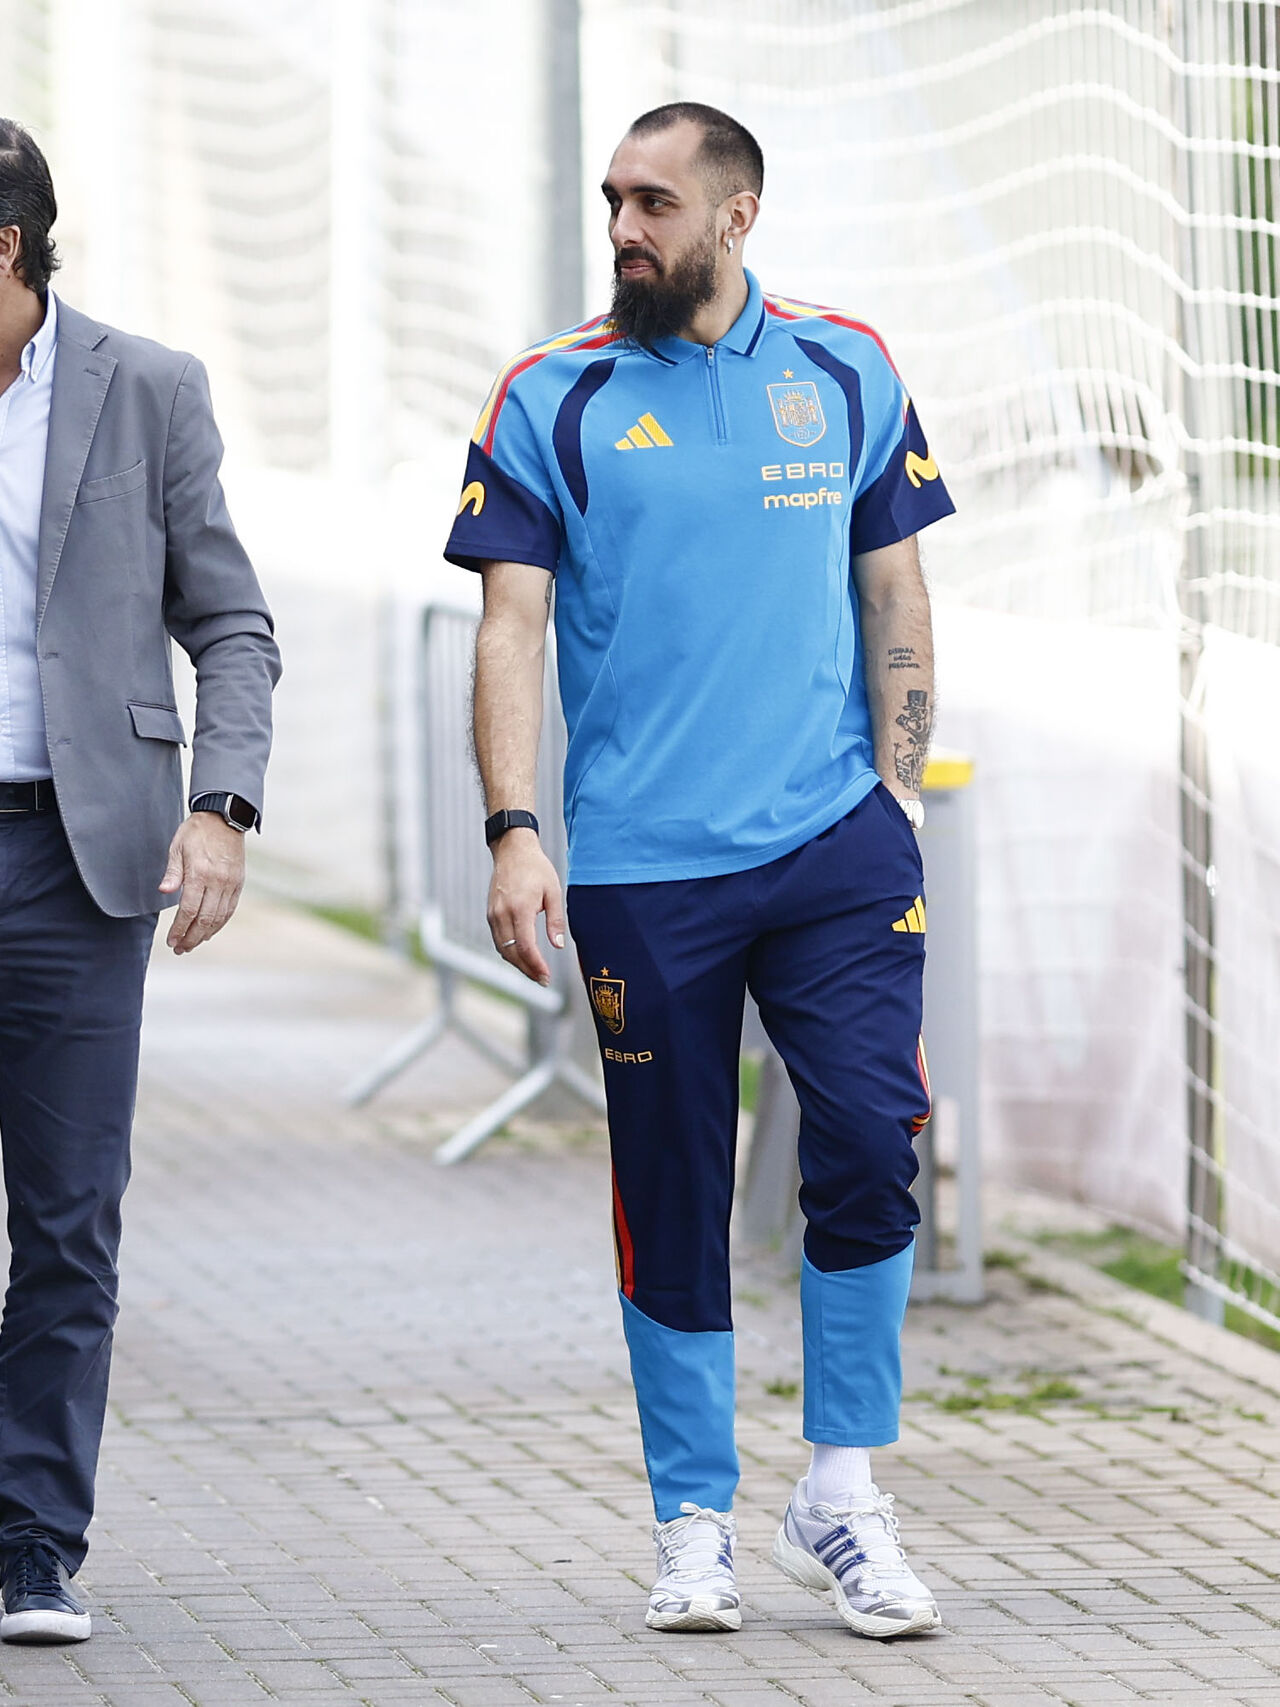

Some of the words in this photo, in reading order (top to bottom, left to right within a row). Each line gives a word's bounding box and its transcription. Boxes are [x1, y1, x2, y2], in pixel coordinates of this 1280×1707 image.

[761, 462, 844, 481] EBRO
[763, 487, 842, 510] mapfre
[604, 1047, 653, 1064] EBRO
